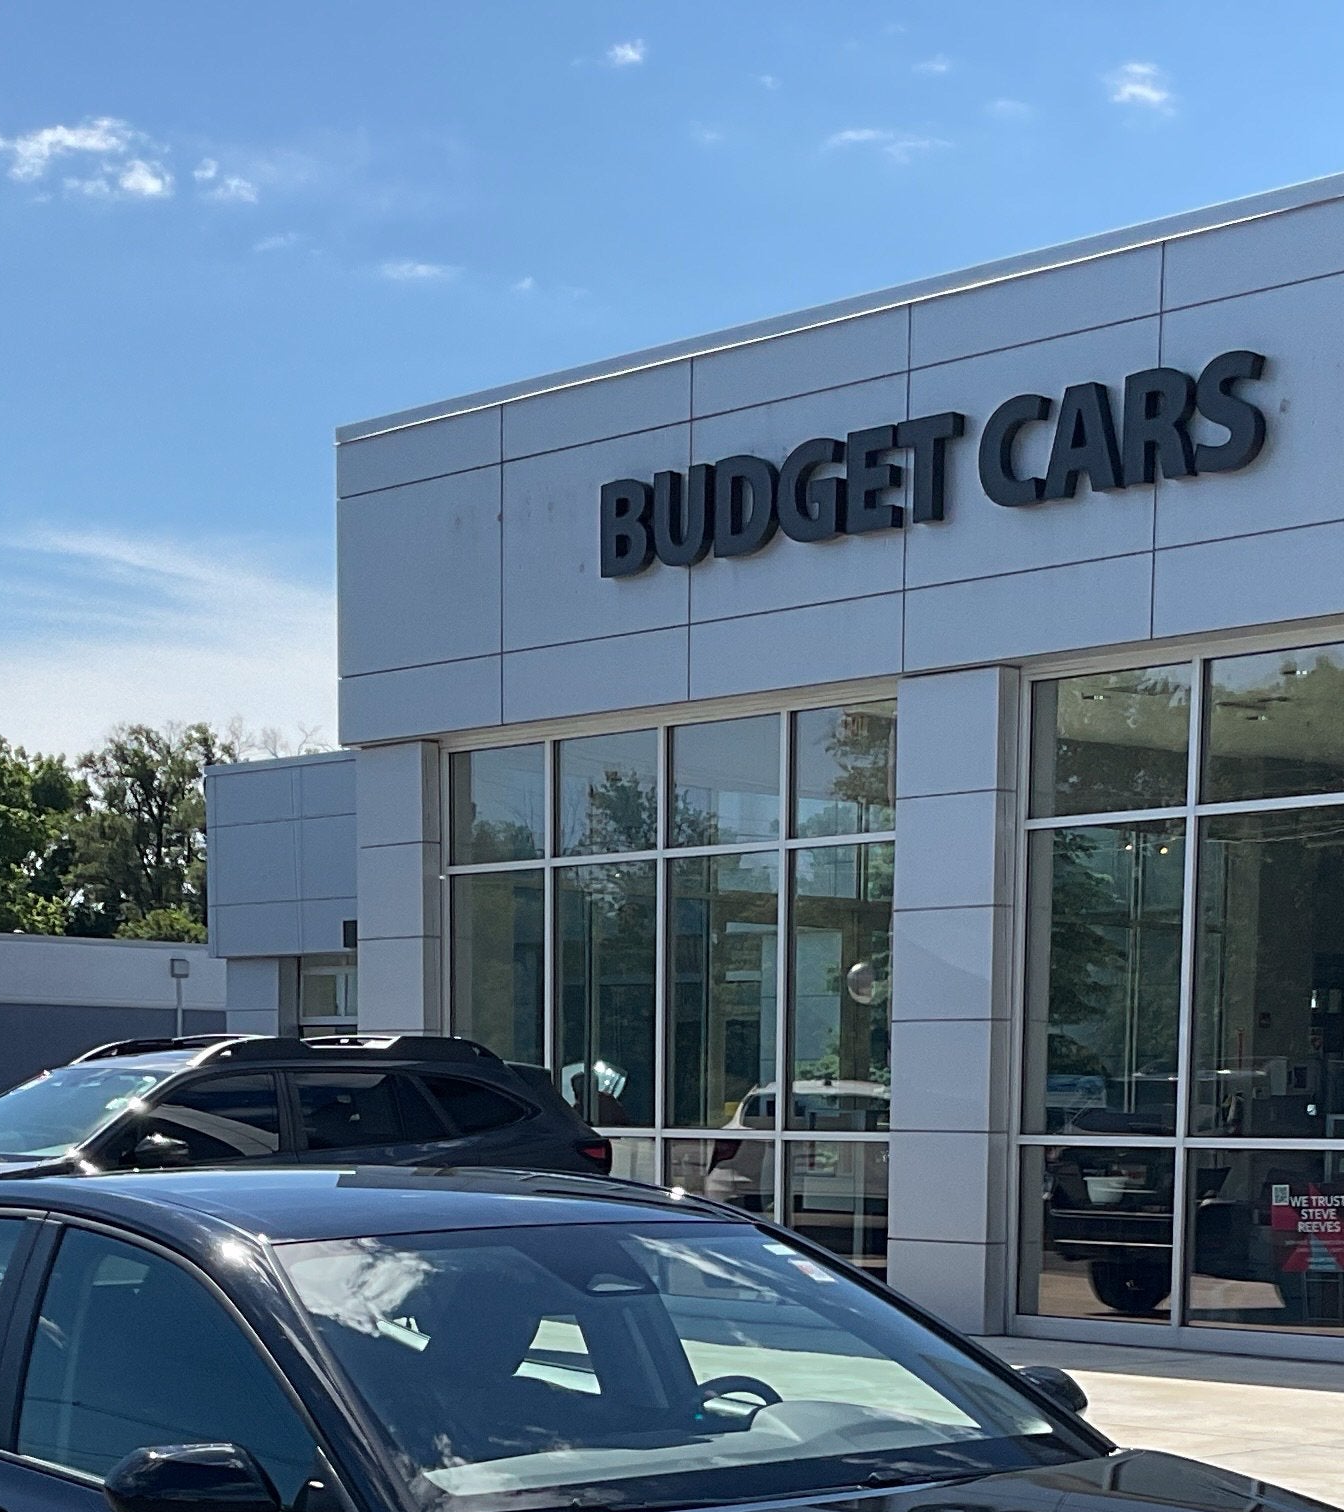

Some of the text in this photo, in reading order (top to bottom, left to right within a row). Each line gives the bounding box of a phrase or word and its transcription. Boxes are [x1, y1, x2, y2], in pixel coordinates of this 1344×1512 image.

[600, 350, 1266, 578] BUDGET CARS
[1290, 1195, 1309, 1207] WE
[1301, 1208, 1337, 1220] STEVE
[1297, 1221, 1342, 1233] REEVES
